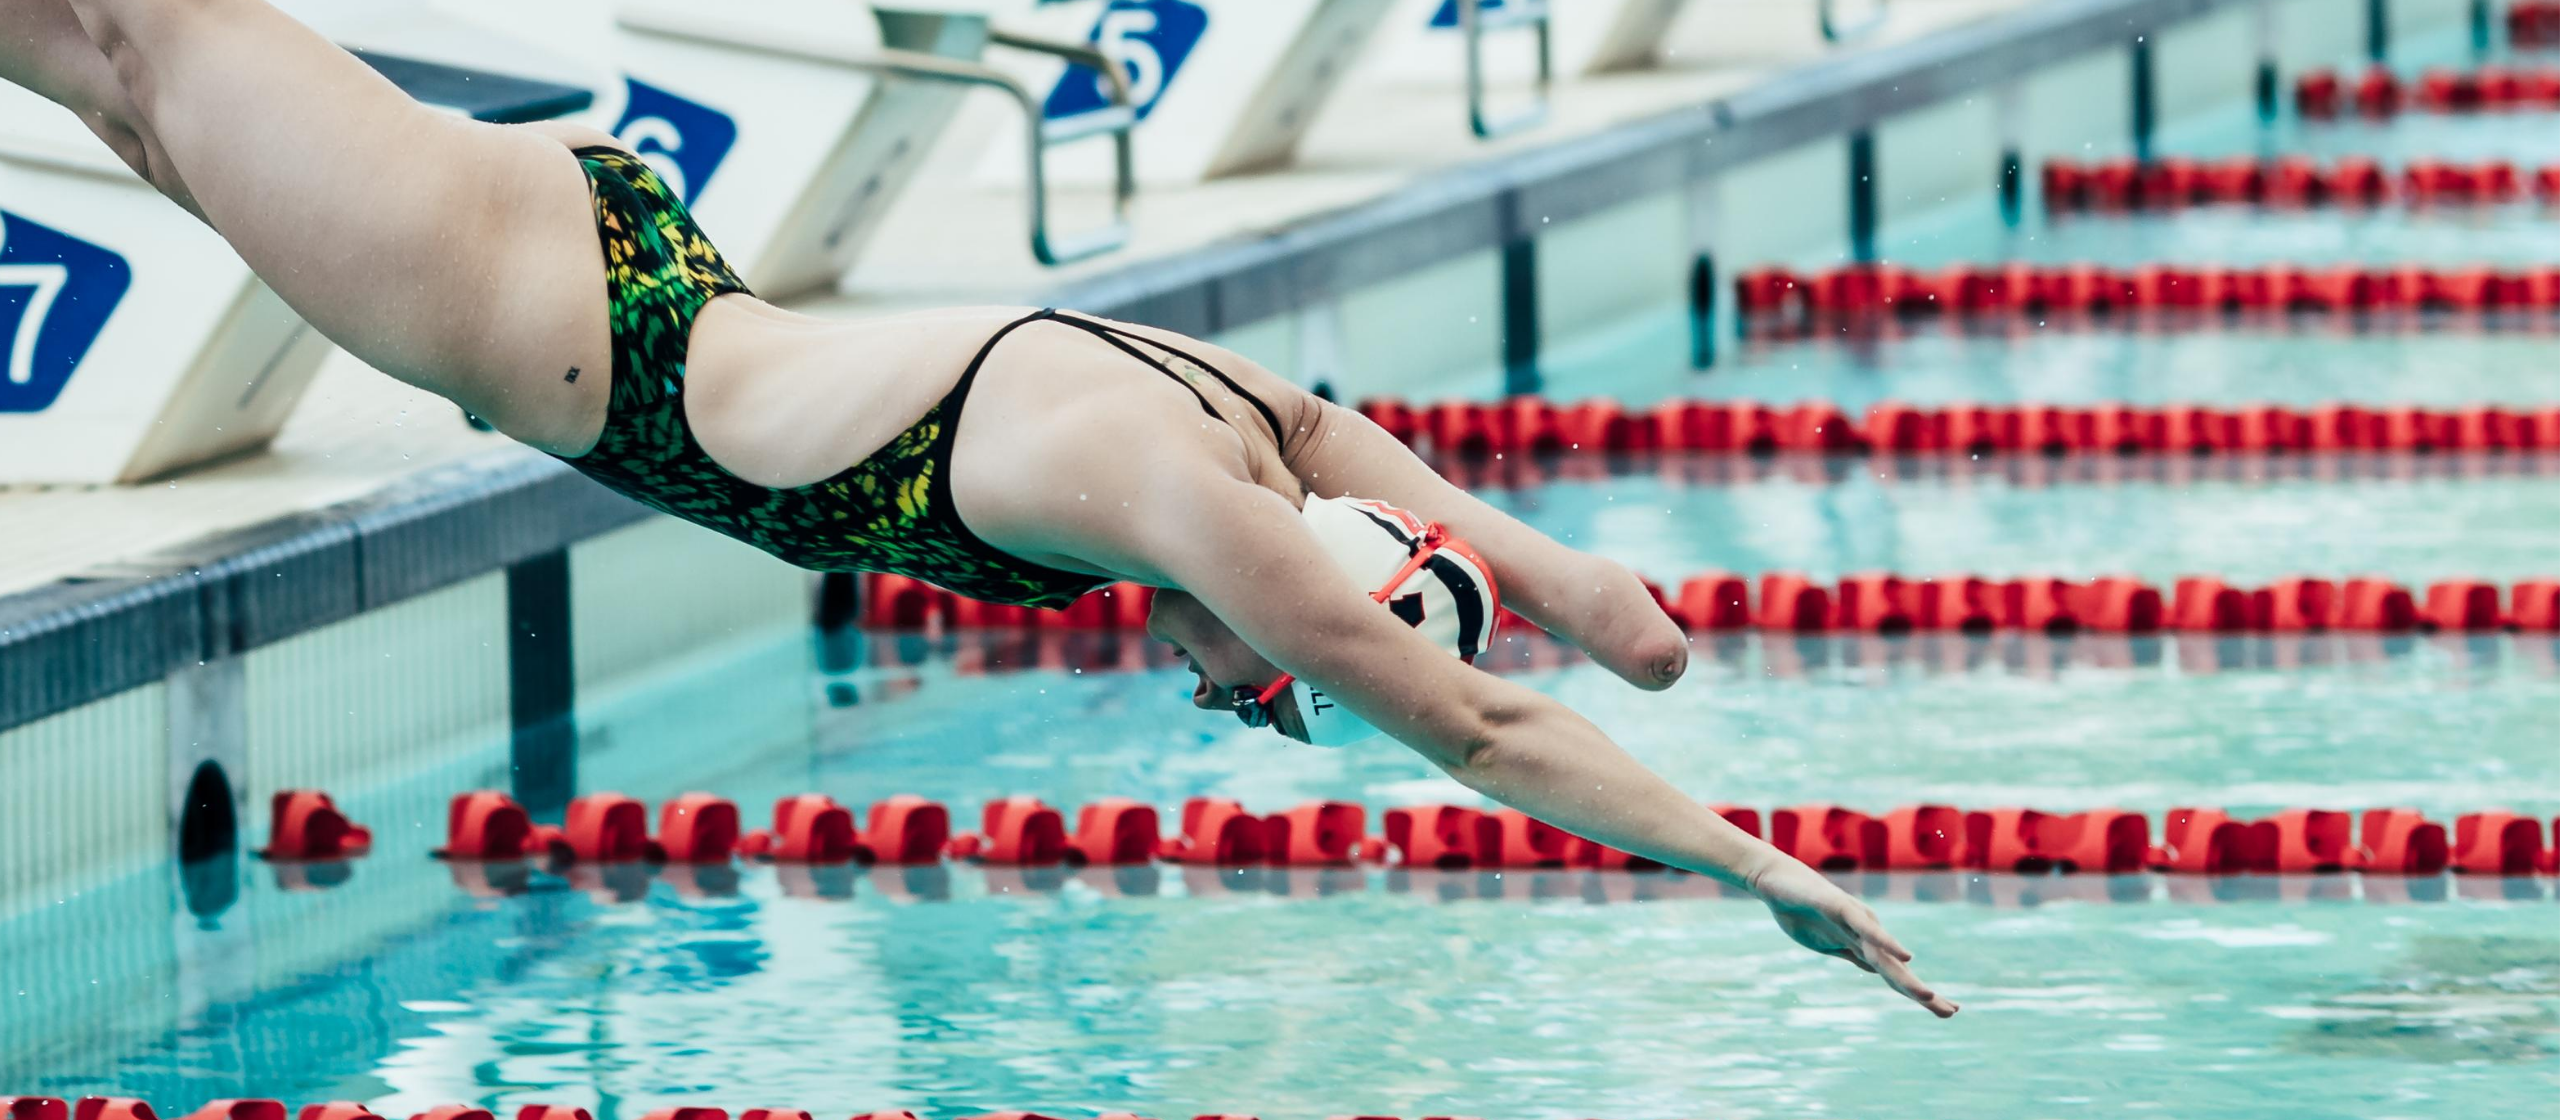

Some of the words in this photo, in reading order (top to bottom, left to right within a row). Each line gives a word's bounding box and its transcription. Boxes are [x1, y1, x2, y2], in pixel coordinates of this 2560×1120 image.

[1097, 10, 1163, 107] 5
[617, 115, 686, 205] 6
[0, 264, 68, 384] 7
